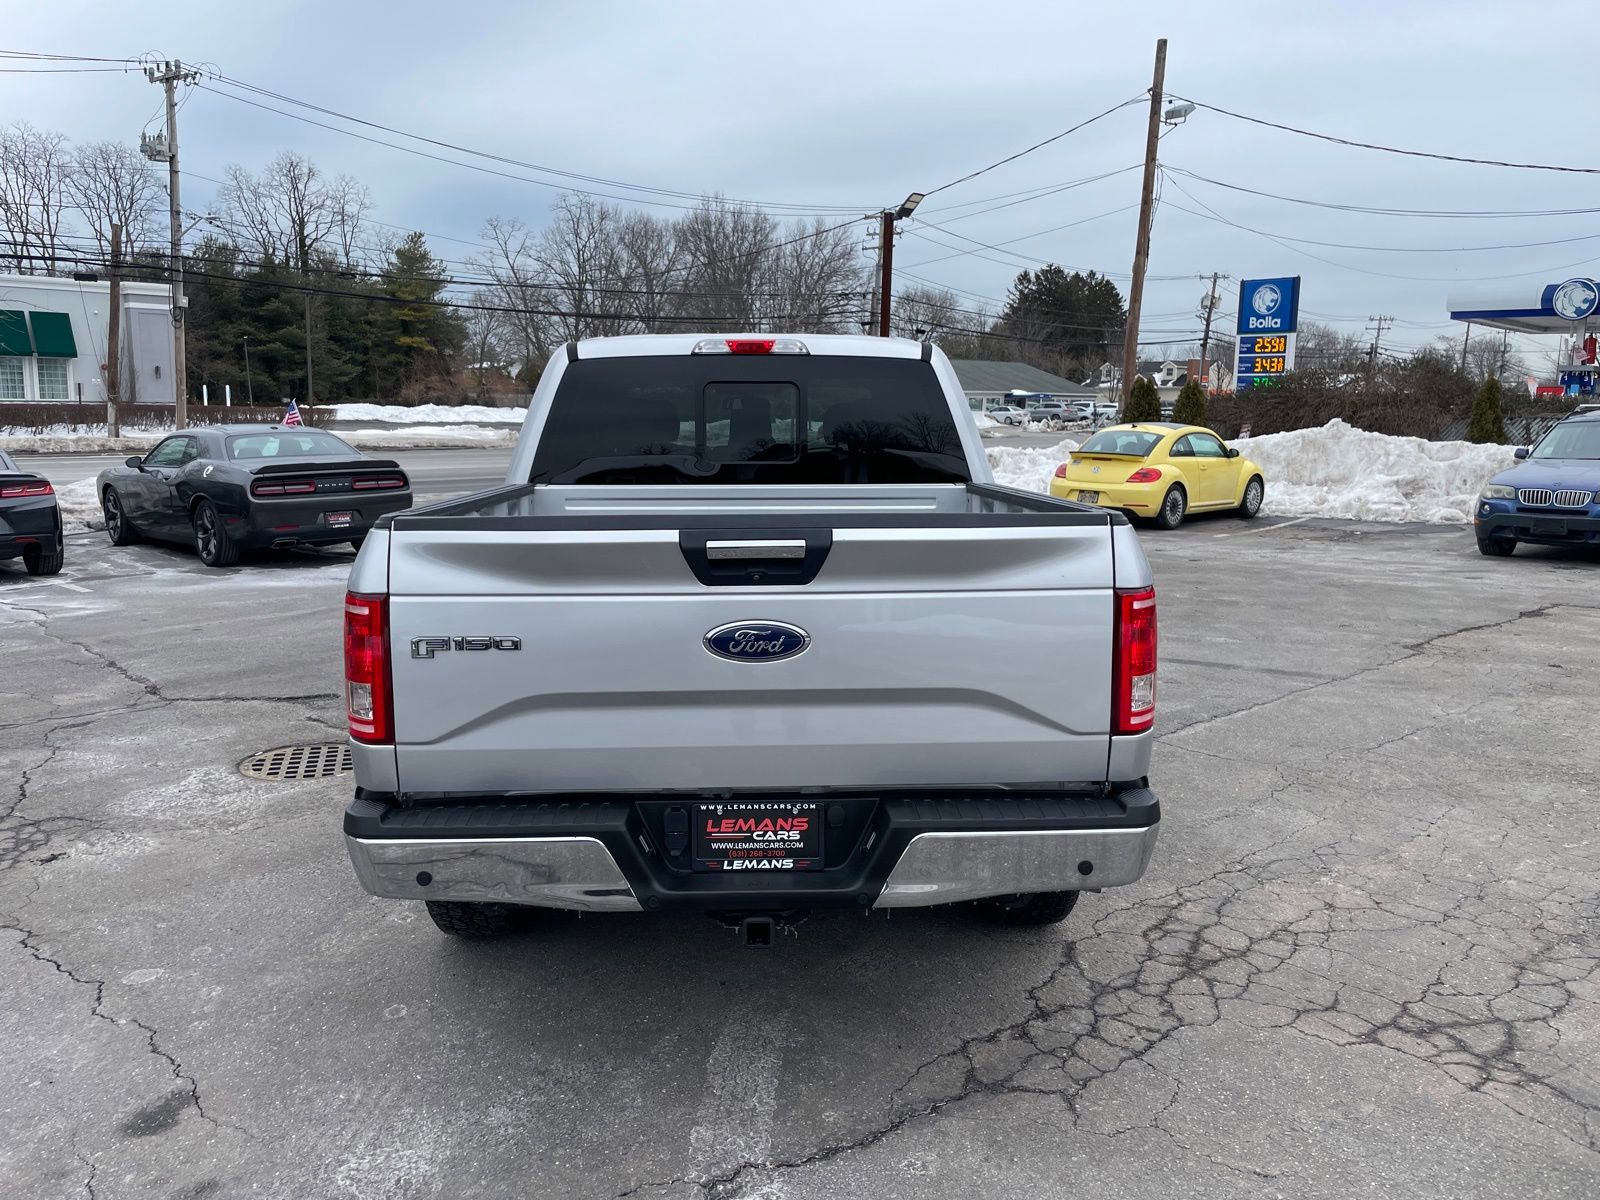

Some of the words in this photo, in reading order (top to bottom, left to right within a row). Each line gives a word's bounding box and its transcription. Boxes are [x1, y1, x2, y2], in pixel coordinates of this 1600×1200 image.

[1249, 316, 1281, 329] Bolla
[729, 630, 785, 653] Ford
[707, 818, 809, 832] LEMANS
[752, 831, 801, 840] CARS
[723, 859, 794, 870] LEMANS
